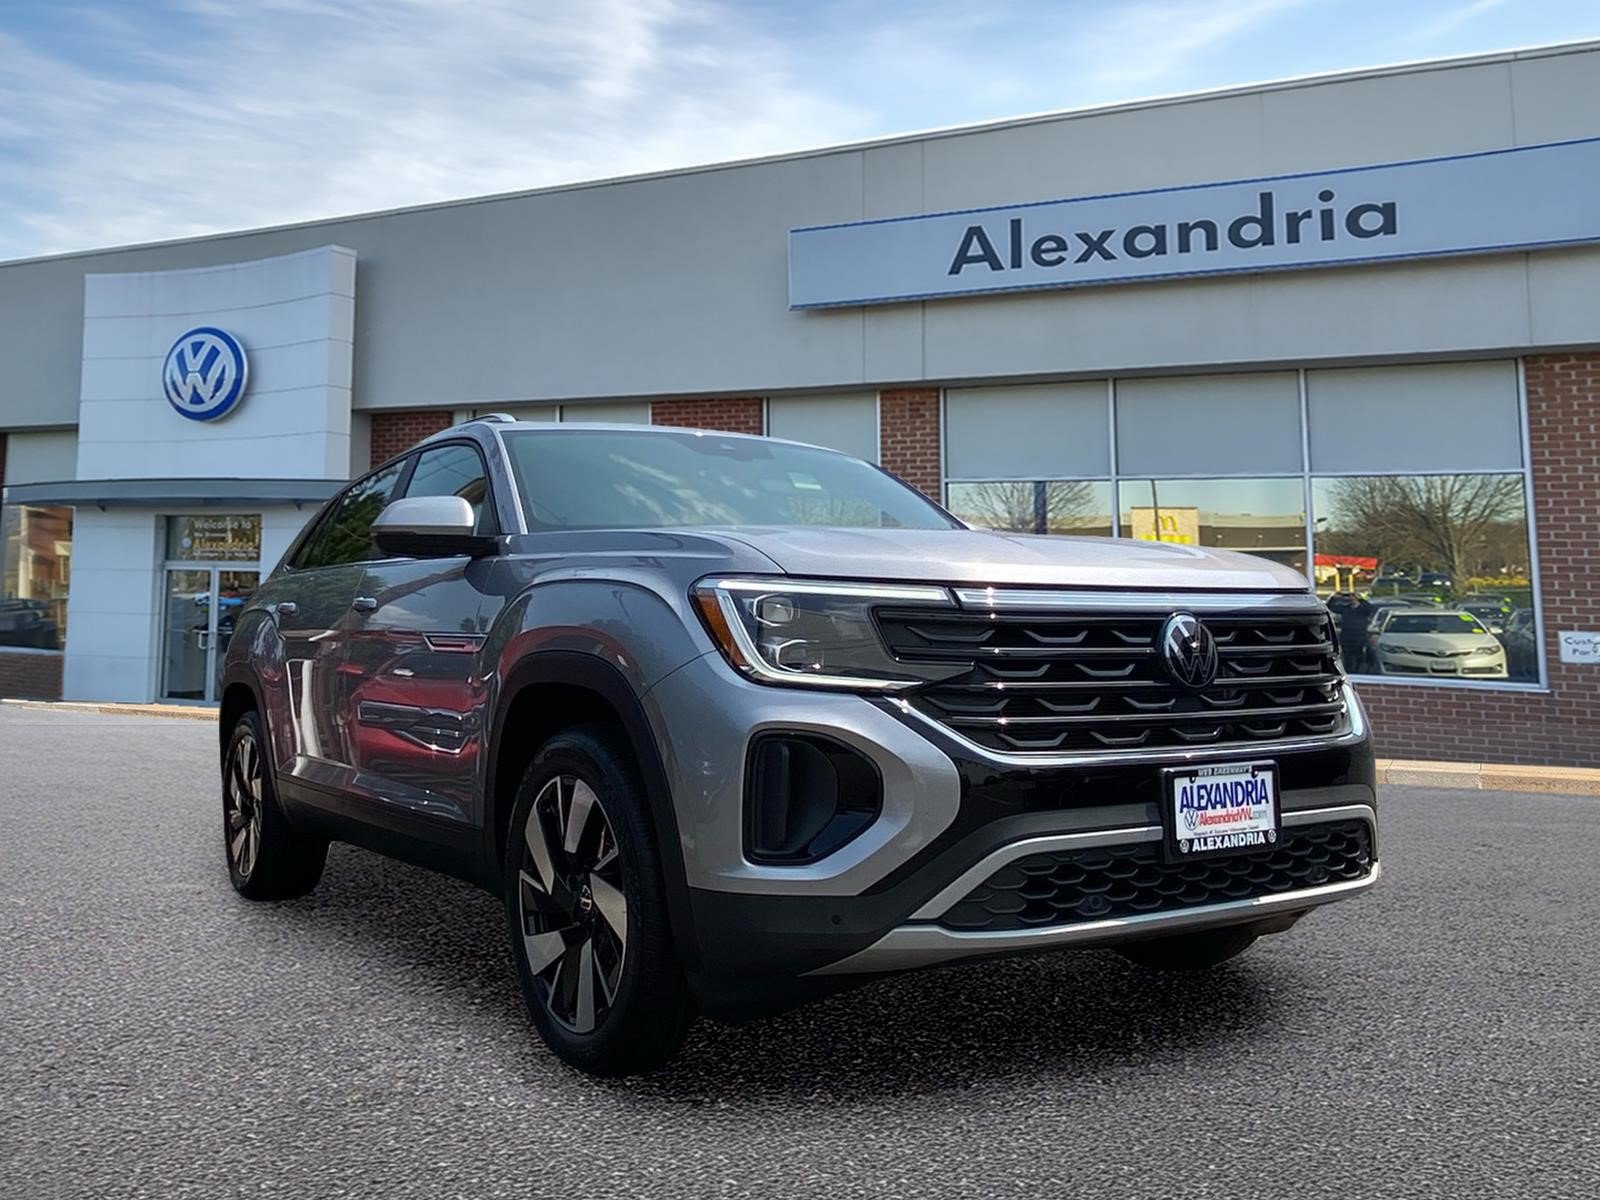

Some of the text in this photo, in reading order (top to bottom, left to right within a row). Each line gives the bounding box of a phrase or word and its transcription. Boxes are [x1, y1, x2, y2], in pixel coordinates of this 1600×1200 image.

[948, 189, 1398, 275] Alexandria
[165, 330, 240, 415] VW
[1180, 779, 1269, 813] ALEXANDRIA
[1192, 832, 1266, 852] ALEXANDRIA
